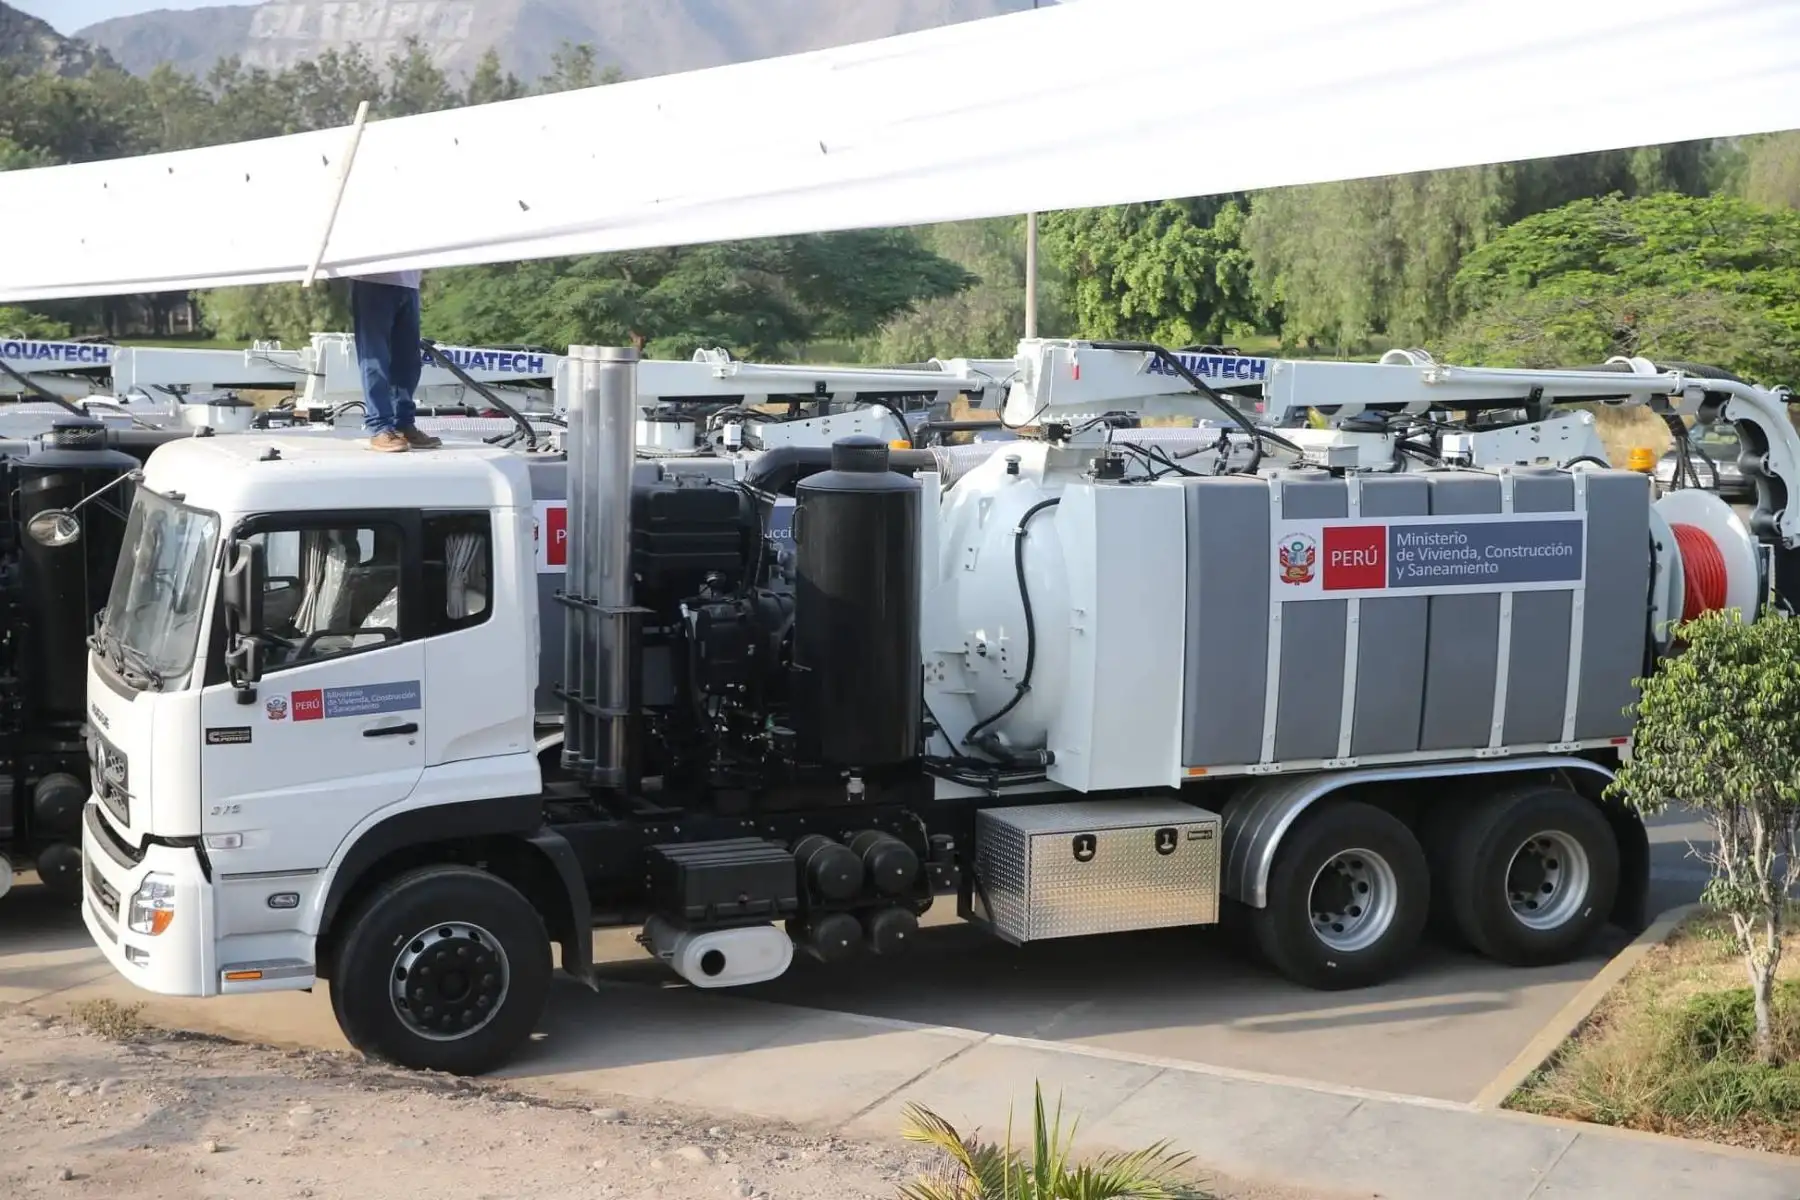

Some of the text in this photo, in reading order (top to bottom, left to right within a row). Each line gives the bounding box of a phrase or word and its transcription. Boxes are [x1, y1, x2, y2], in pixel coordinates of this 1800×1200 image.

[1396, 531, 1468, 547] Ministerio
[1331, 545, 1378, 567] PERÚ
[1396, 542, 1574, 562] de Vivienda, Construcción
[1396, 561, 1499, 580] y Saneamiento
[295, 698, 320, 711] PERÚ
